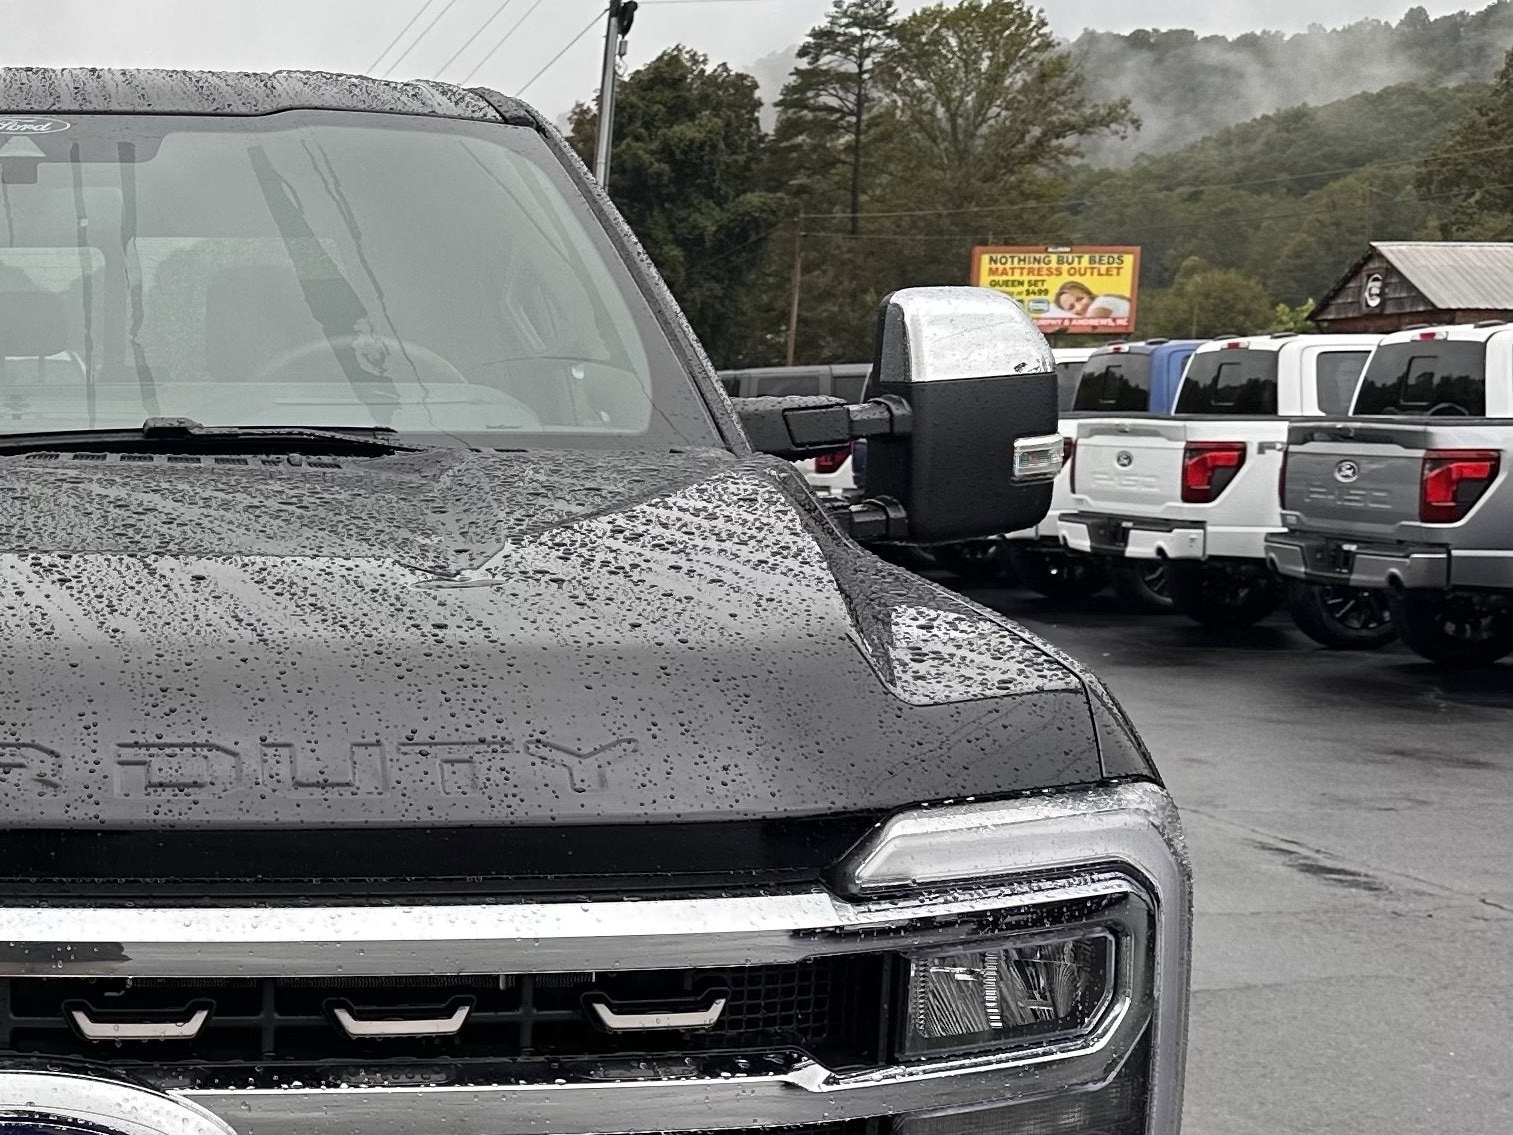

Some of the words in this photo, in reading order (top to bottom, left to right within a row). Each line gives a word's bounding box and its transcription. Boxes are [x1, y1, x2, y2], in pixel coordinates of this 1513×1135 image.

[989, 255, 1052, 266] NOTHING
[1057, 255, 1084, 265] BUT
[1089, 255, 1124, 265] BEDS
[988, 266, 1063, 277] MATTRESS
[1067, 266, 1123, 276] OUTLET
[989, 279, 1025, 288] QUEEN
[1027, 279, 1046, 288] SET
[1025, 288, 1049, 296] $499
[1305, 485, 1392, 509] F-150
[112, 738, 640, 797] DUTY
